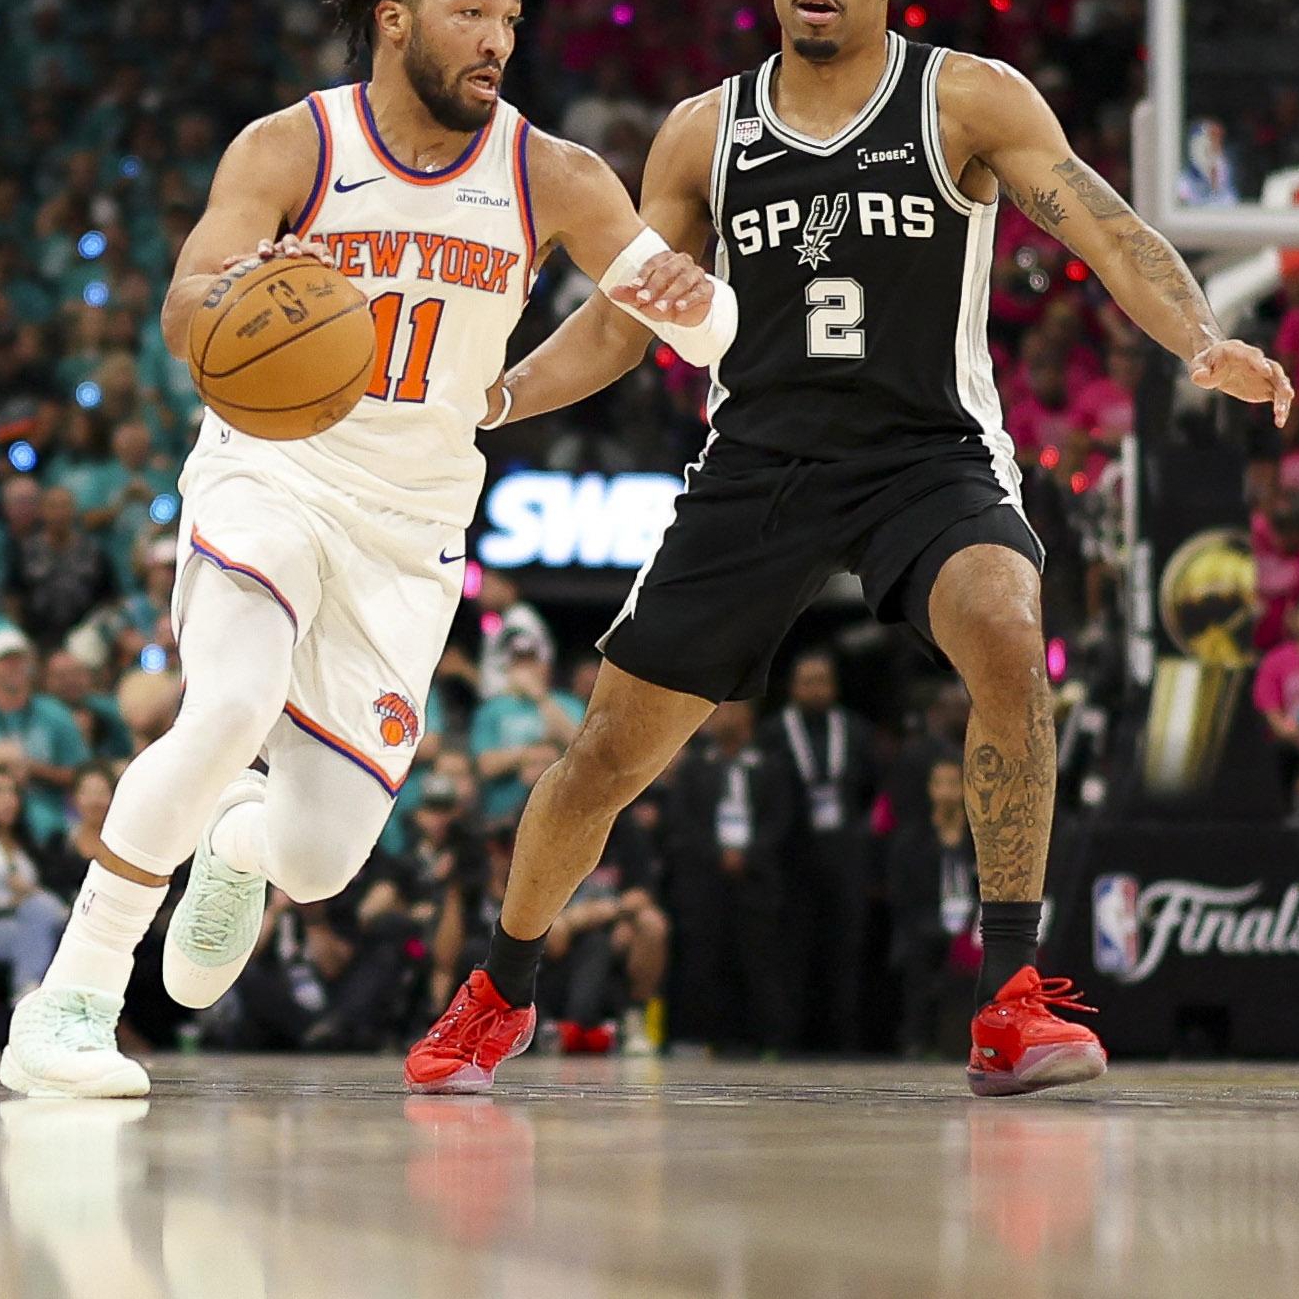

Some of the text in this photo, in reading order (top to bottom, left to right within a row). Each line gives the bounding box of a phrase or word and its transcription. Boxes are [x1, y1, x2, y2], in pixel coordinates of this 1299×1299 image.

[864, 148, 908, 164] LEDGER
[311, 231, 520, 295] NEW YORK
[731, 191, 936, 271] SPURS
[366, 291, 446, 404] 11
[804, 277, 866, 359] 2
